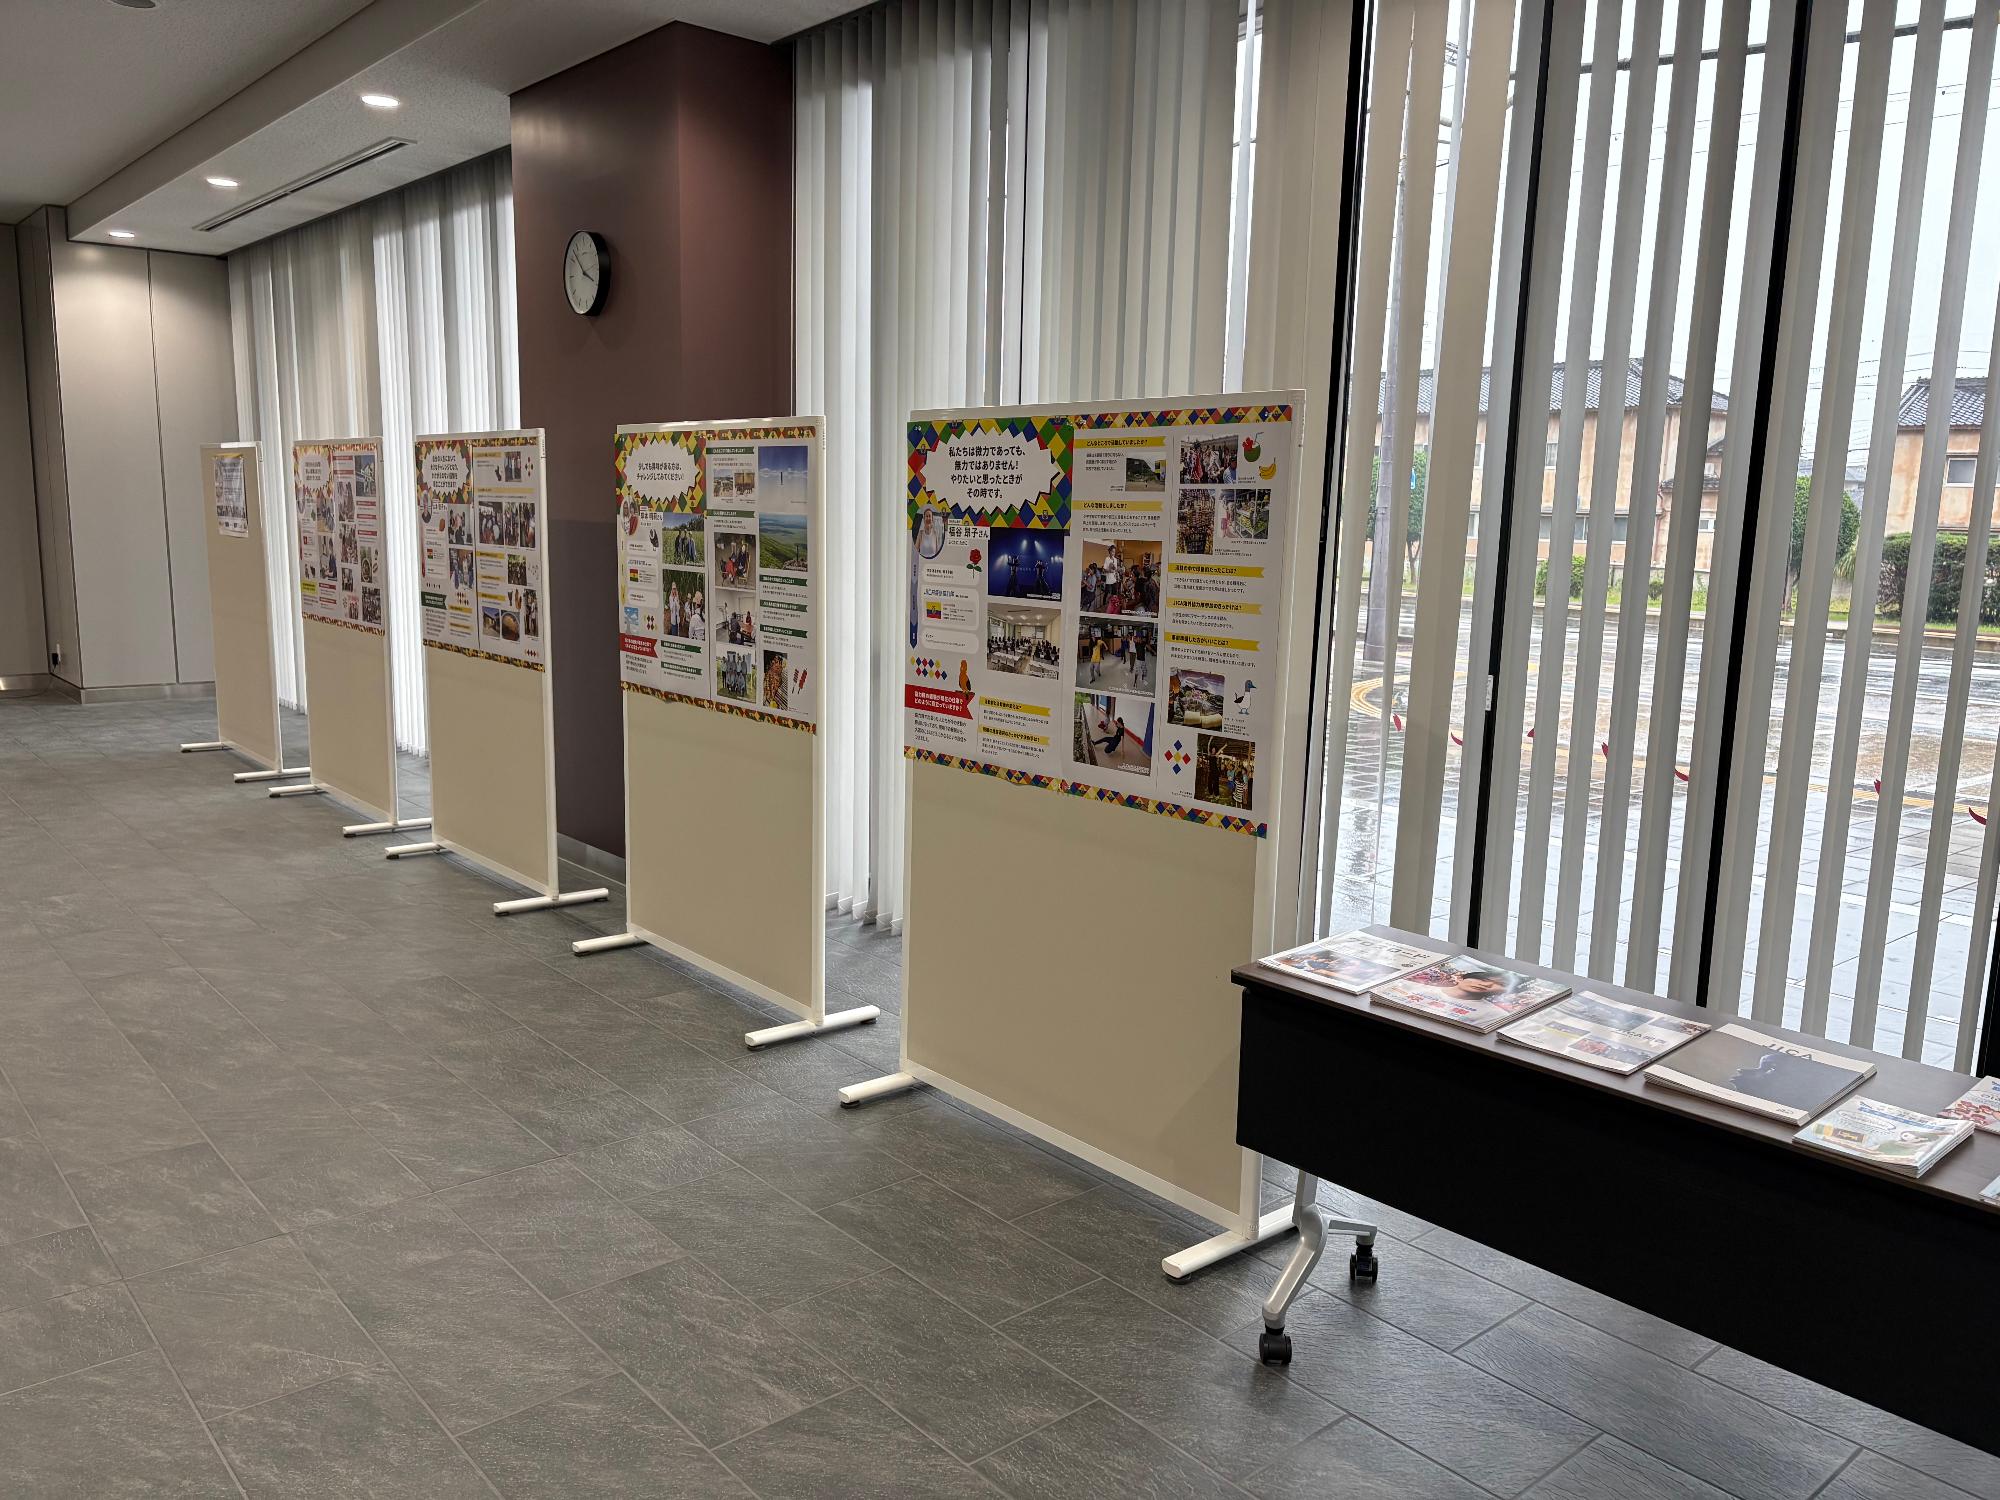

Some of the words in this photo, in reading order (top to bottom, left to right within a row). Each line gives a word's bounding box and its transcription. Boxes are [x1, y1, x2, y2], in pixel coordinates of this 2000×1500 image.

[949, 446, 1026, 458] 私たちは微力であっても、
[954, 460, 1019, 471] 無力ではありません!
[950, 474, 1023, 485] やりたいと思ったときが
[967, 488, 1003, 499] その時です。
[1763, 1043, 1813, 1061] JICA
